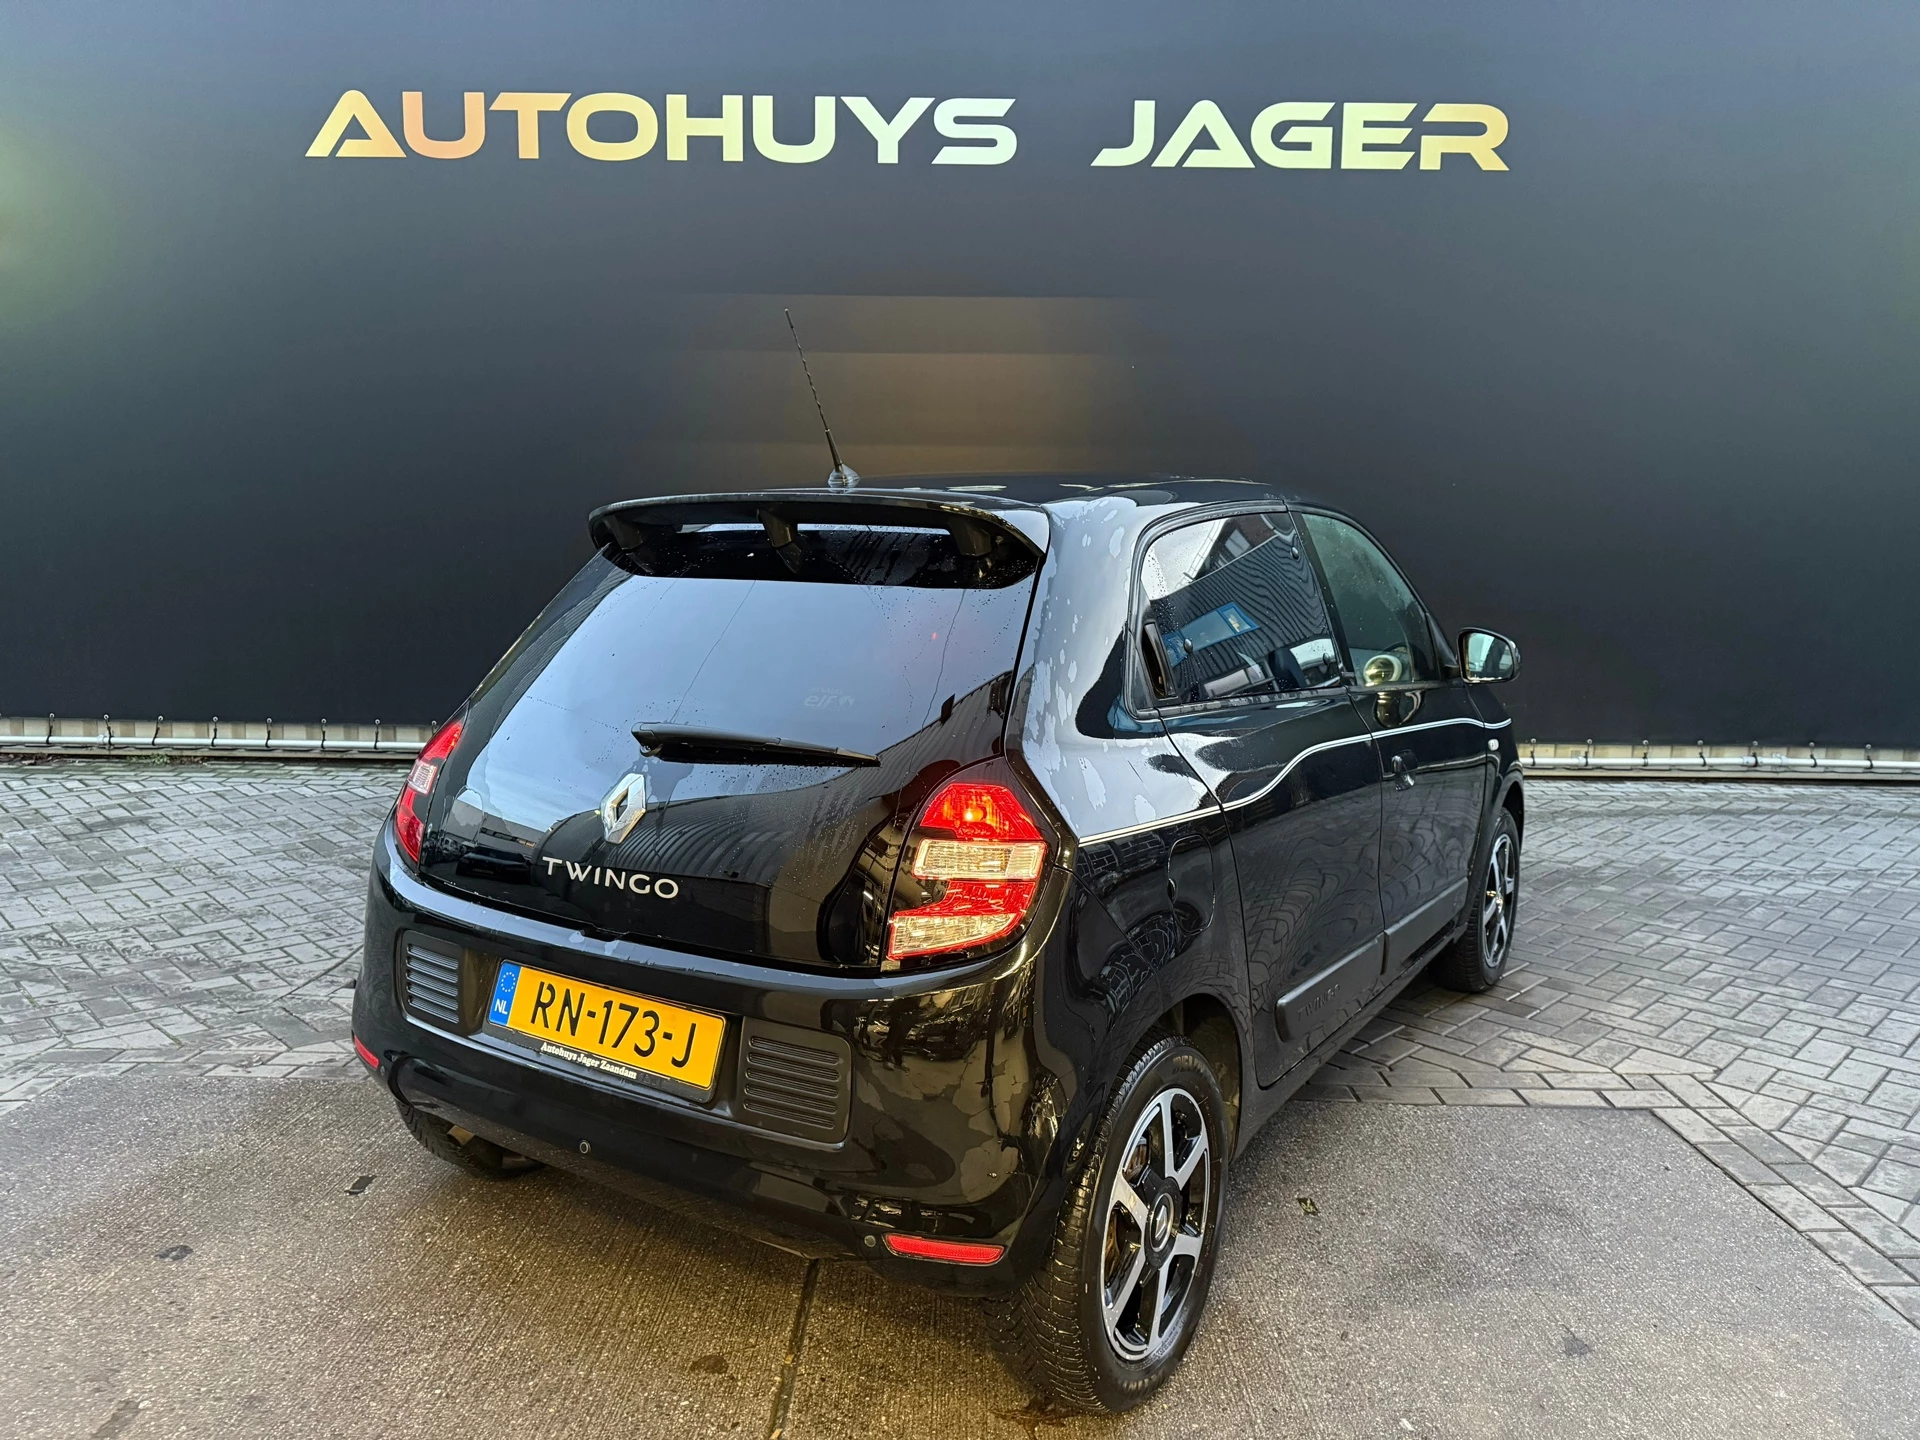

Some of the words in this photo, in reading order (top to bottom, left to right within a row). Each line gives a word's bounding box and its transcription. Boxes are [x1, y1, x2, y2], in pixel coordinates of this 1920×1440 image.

[304, 89, 1018, 165] AUTOHUYS
[1090, 99, 1510, 171] JAGER
[542, 856, 679, 899] TWINGO
[494, 998, 509, 1015] NL
[530, 980, 697, 1068] RN-173-J
[540, 1042, 577, 1061] Autohuys
[576, 1053, 600, 1068] Jager
[599, 1060, 638, 1080] Zaandam
